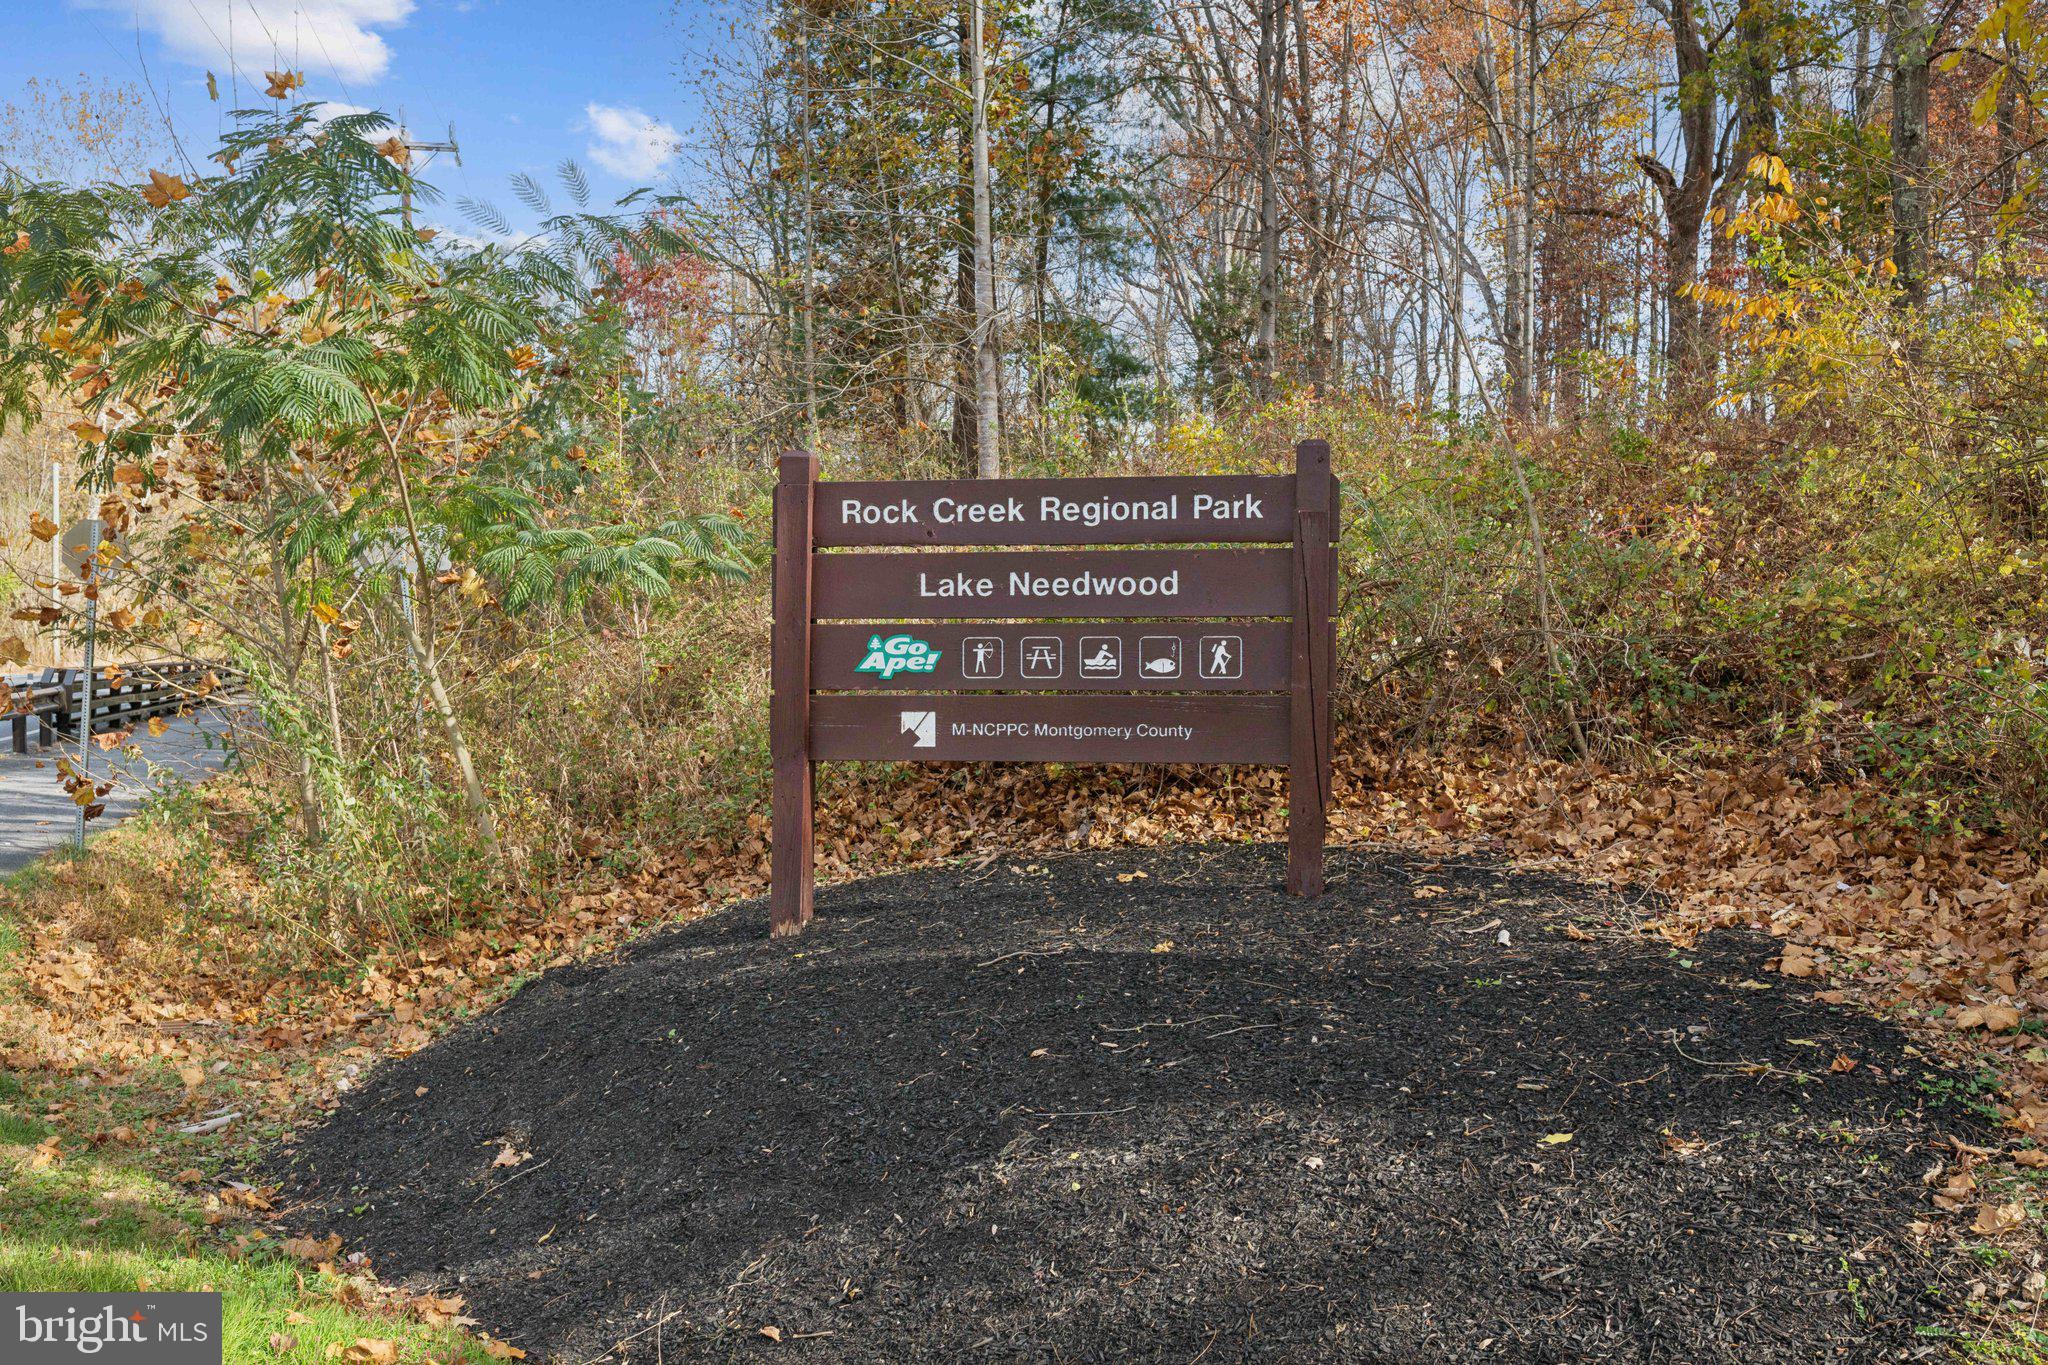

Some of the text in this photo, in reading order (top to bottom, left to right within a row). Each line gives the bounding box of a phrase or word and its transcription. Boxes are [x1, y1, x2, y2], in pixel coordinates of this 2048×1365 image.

[841, 493, 1263, 528] Rock Creek Regional Park
[919, 571, 1179, 598] Lake Needwood
[885, 636, 927, 656] Go
[860, 650, 939, 676] Ape!
[951, 722, 1193, 740] M-NCPPC Montgomery County
